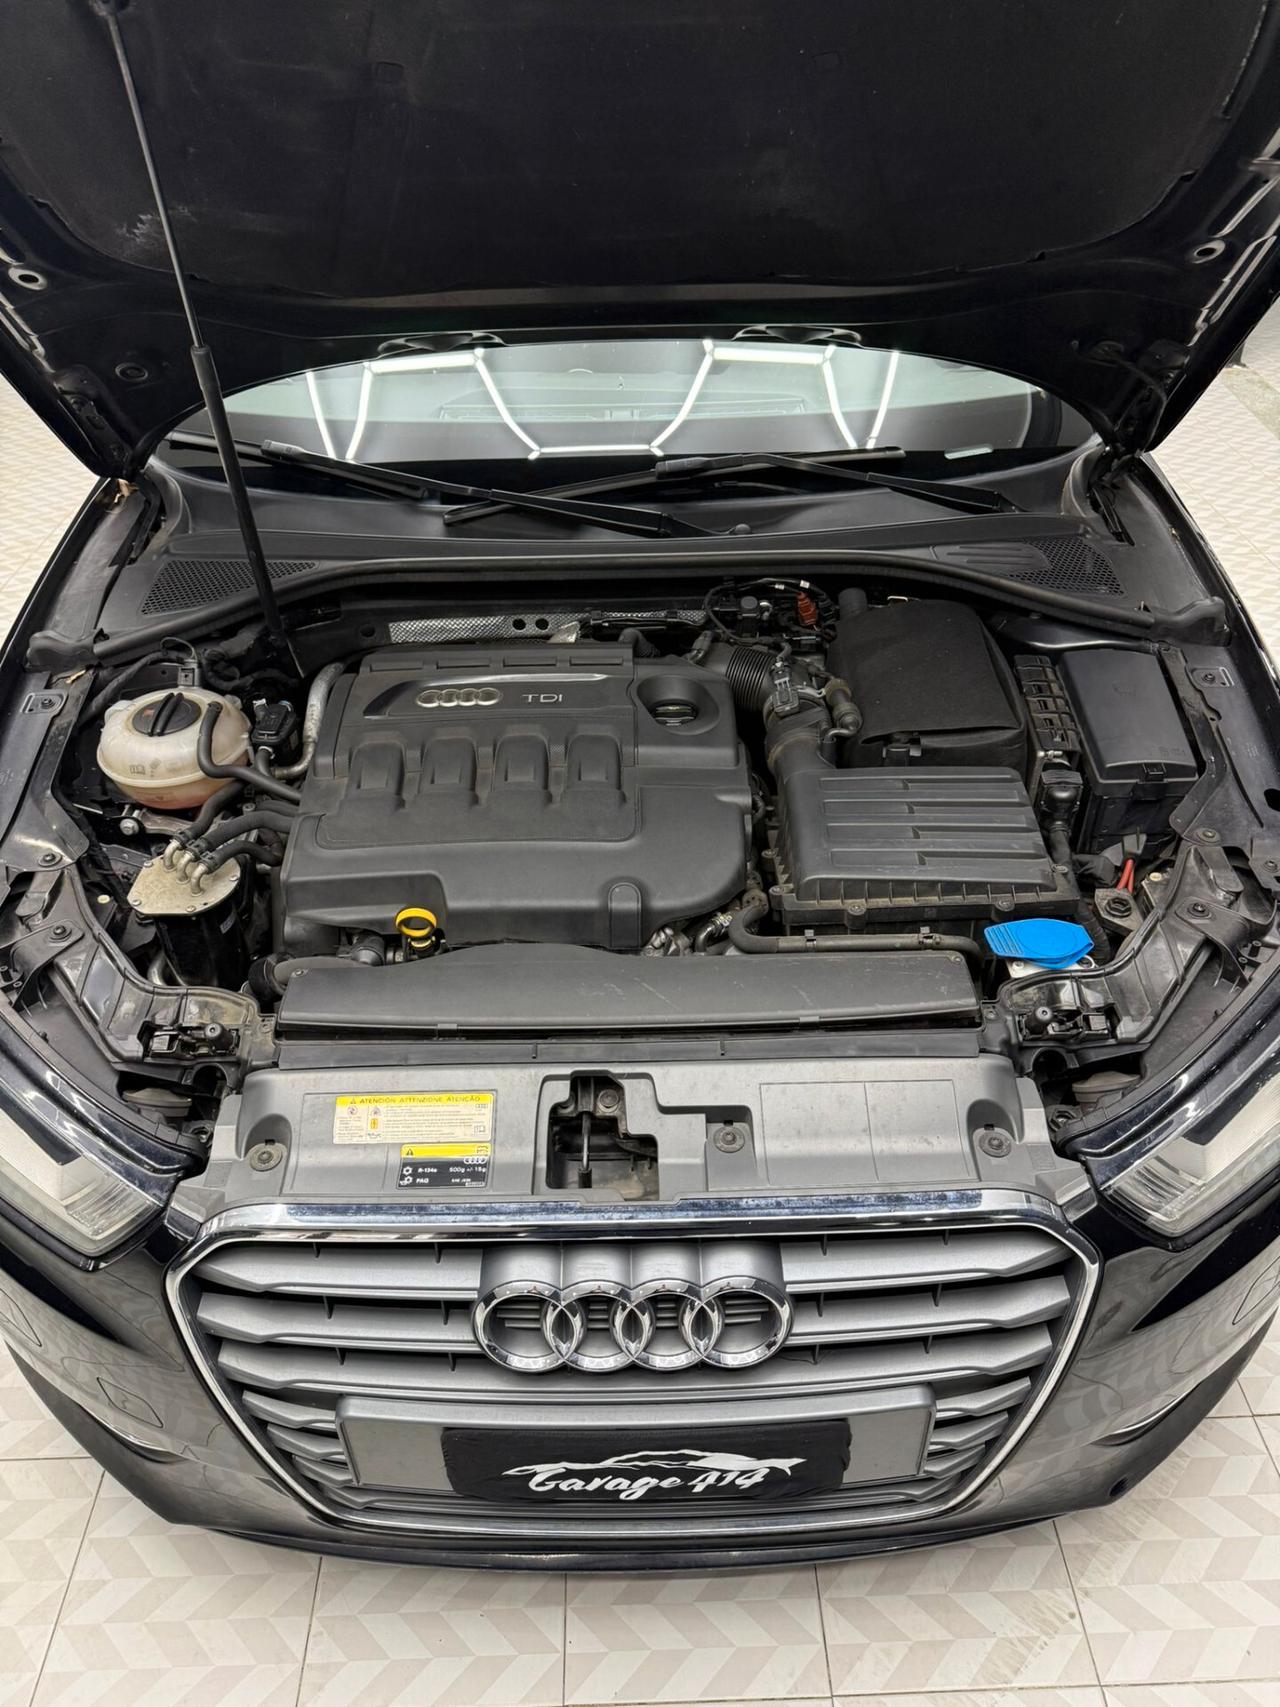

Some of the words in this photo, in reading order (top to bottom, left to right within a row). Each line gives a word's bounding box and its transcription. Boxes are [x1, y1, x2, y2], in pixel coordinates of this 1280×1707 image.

[522, 694, 563, 703] TDI
[446, 1095, 481, 1103] ATENÇÃO
[528, 1469, 685, 1500] Garage
[687, 1467, 770, 1492] 414
